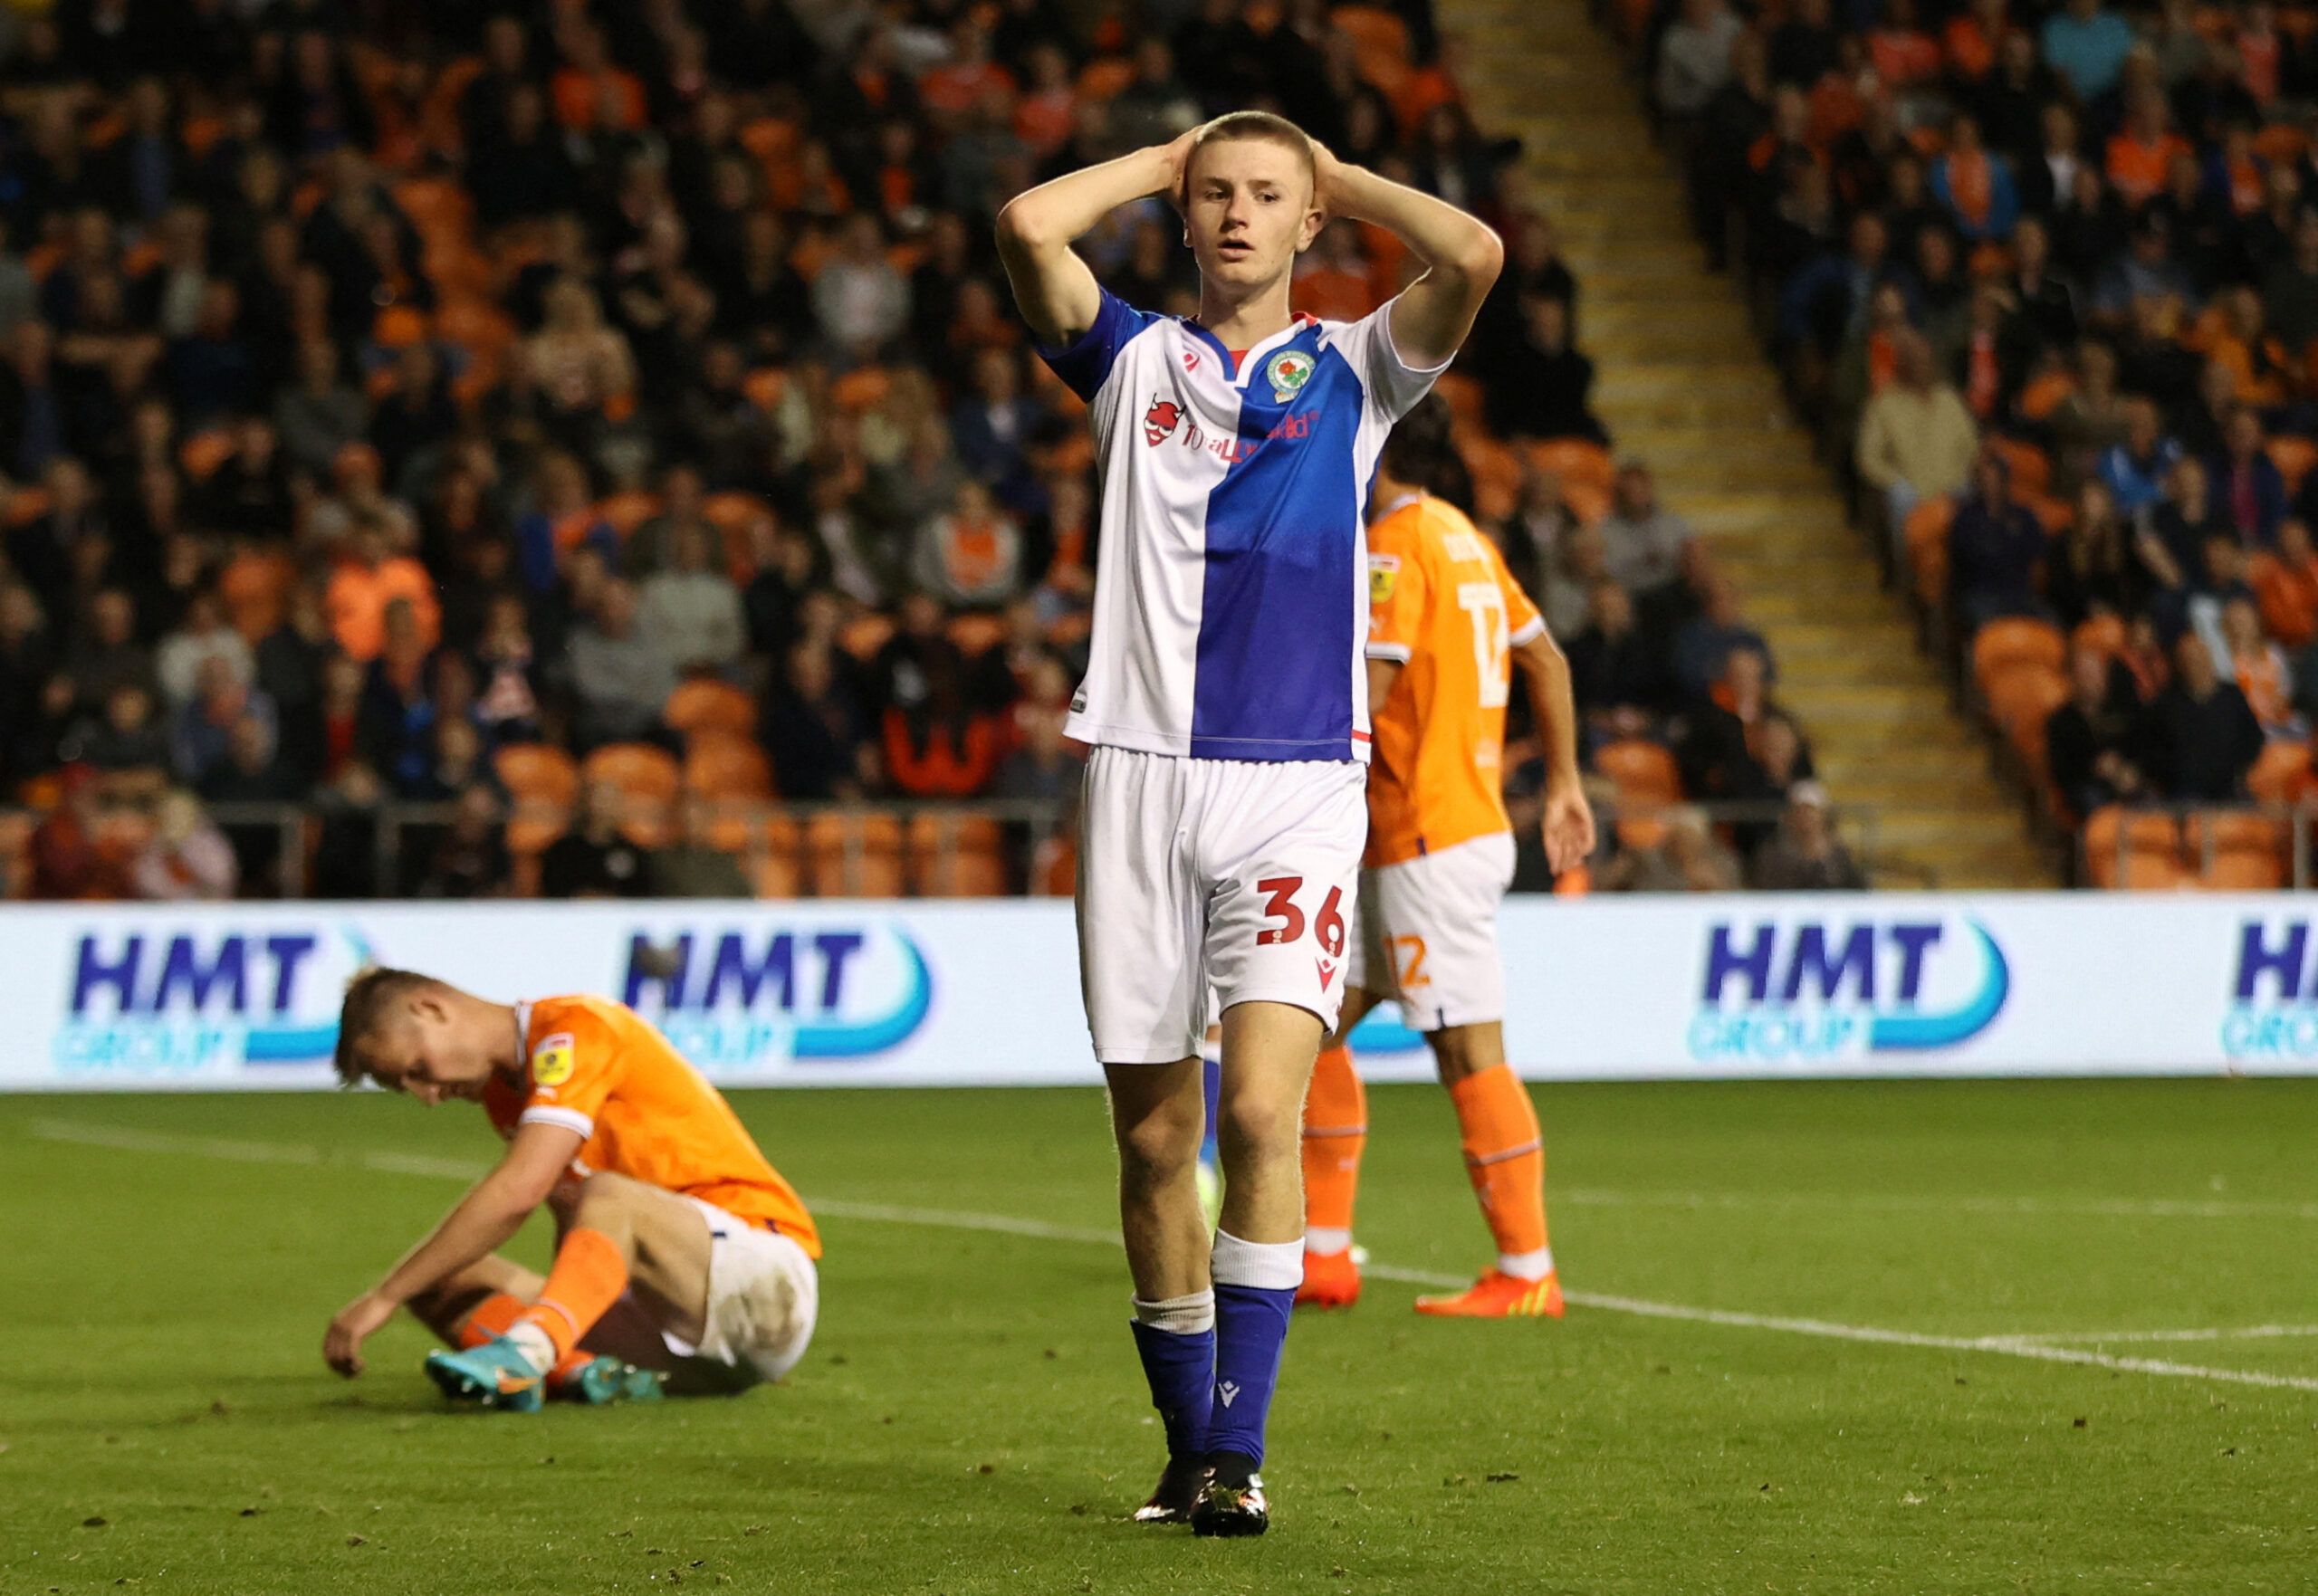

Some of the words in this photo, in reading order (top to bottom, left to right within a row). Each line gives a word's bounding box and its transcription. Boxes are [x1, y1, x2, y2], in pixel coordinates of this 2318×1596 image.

[1256, 876, 1346, 958] 36
[72, 933, 317, 1014] HMT
[623, 933, 865, 1008] HMT
[1381, 934, 1431, 988] 12
[1703, 924, 1943, 999] HMT
[2236, 923, 2318, 999] H
[1688, 1009, 1857, 1059] GROUP
